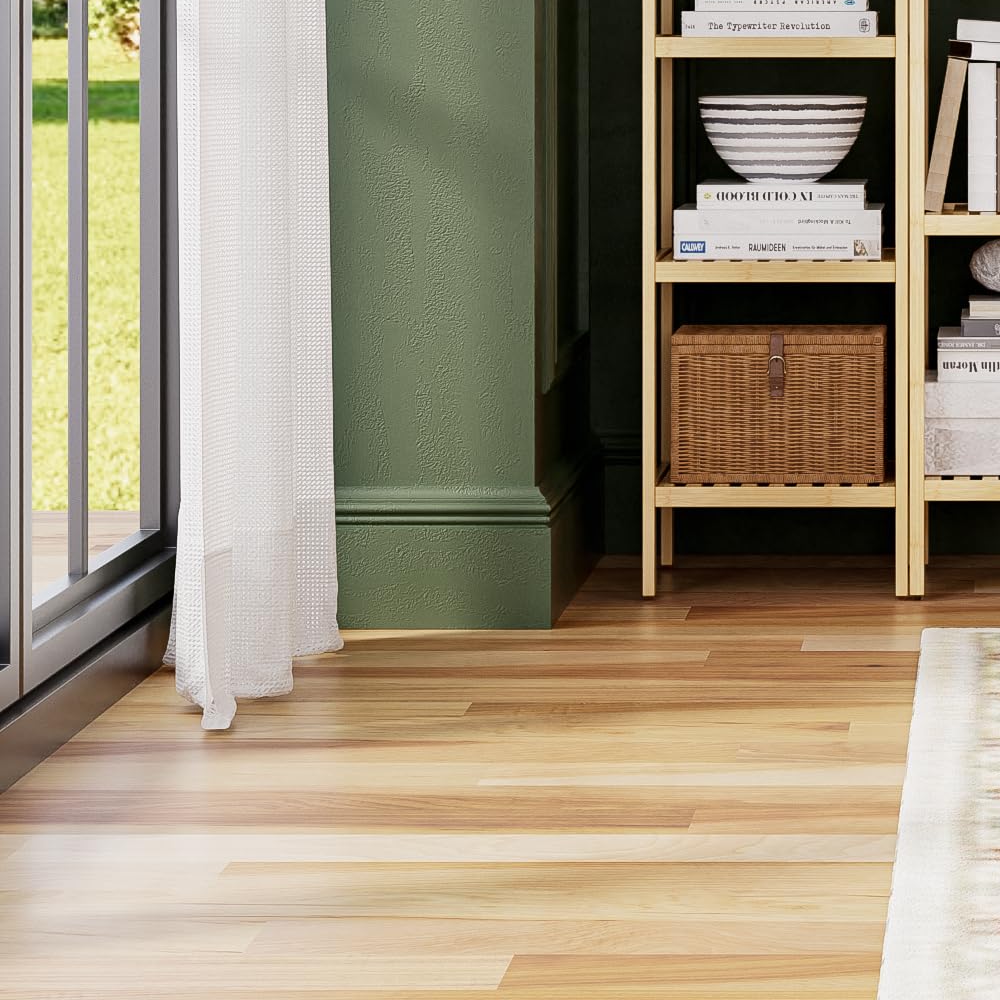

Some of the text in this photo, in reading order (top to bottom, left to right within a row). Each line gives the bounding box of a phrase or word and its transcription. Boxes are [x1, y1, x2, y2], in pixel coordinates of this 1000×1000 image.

[708, 22, 831, 32] The Typewriter Revolution
[716, 191, 813, 201] IN COLD BLOOD
[748, 243, 786, 252] RAUMIDEEN
[942, 361, 978, 373] Moran
